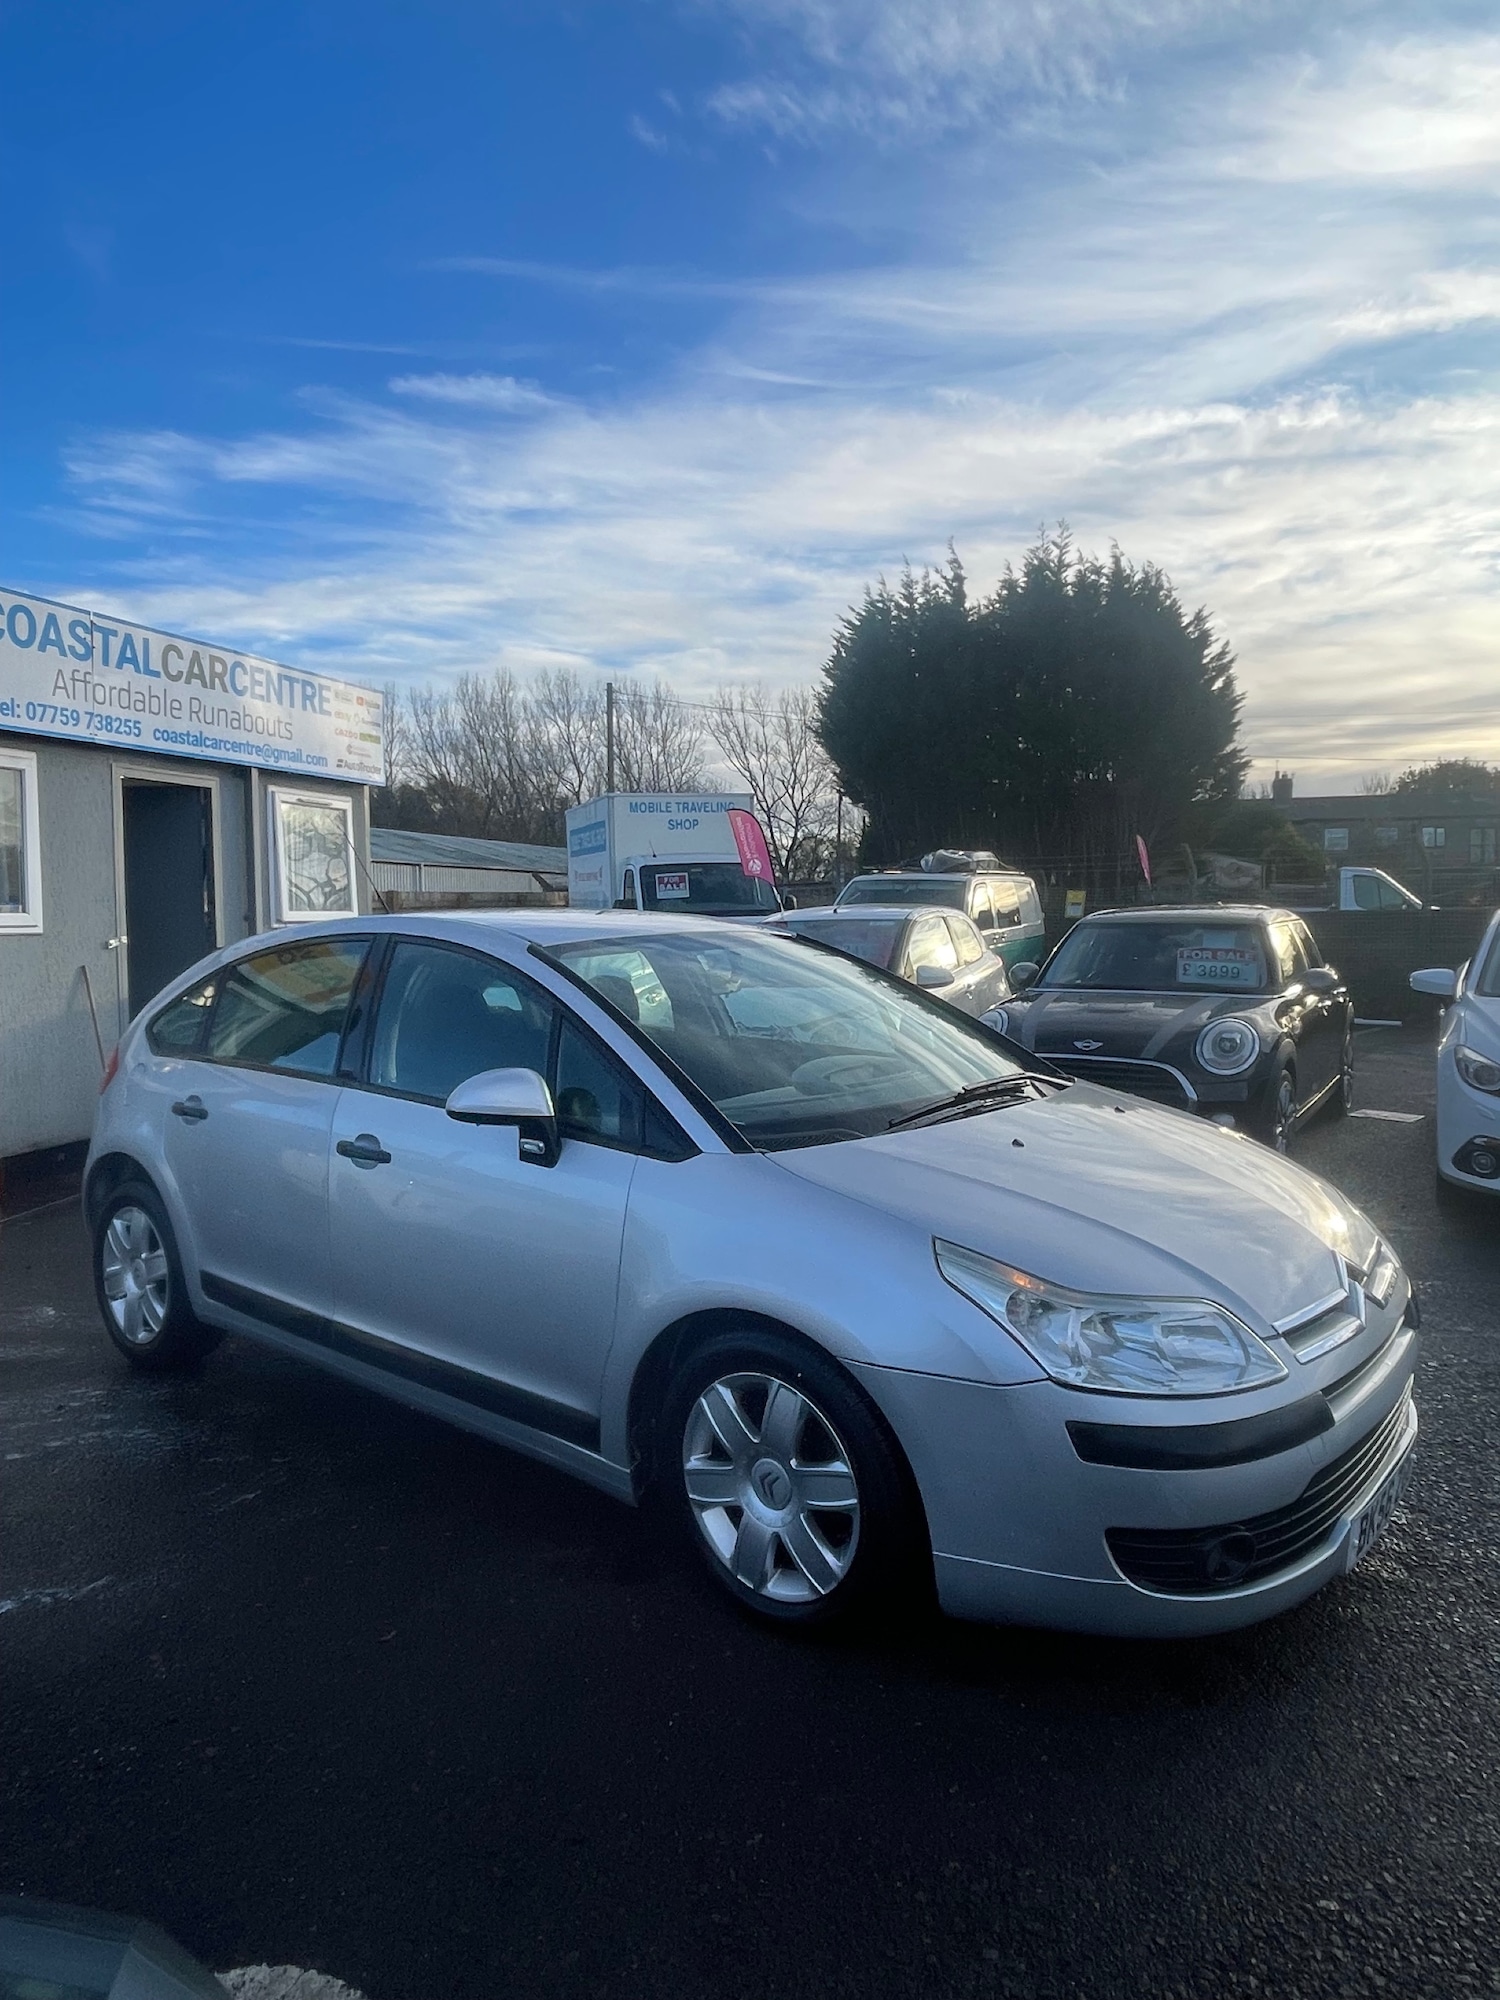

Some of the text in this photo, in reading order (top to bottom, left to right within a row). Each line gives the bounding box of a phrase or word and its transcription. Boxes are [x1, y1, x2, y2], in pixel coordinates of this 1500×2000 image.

[0, 602, 333, 717] OASTALCARCENTRE
[52, 668, 294, 741] Affordable Runabouts
[0, 697, 21, 719] el:
[26, 701, 80, 727] 07759
[84, 711, 142, 738] 738255
[153, 725, 329, 768] coastalcarcentre@gmail.com
[629, 801, 673, 814] MOBILE
[667, 819, 700, 831] SHOP
[663, 876, 680, 884] FOR
[659, 883, 686, 891] SALE
[1183, 950, 1254, 960] FOR SALE
